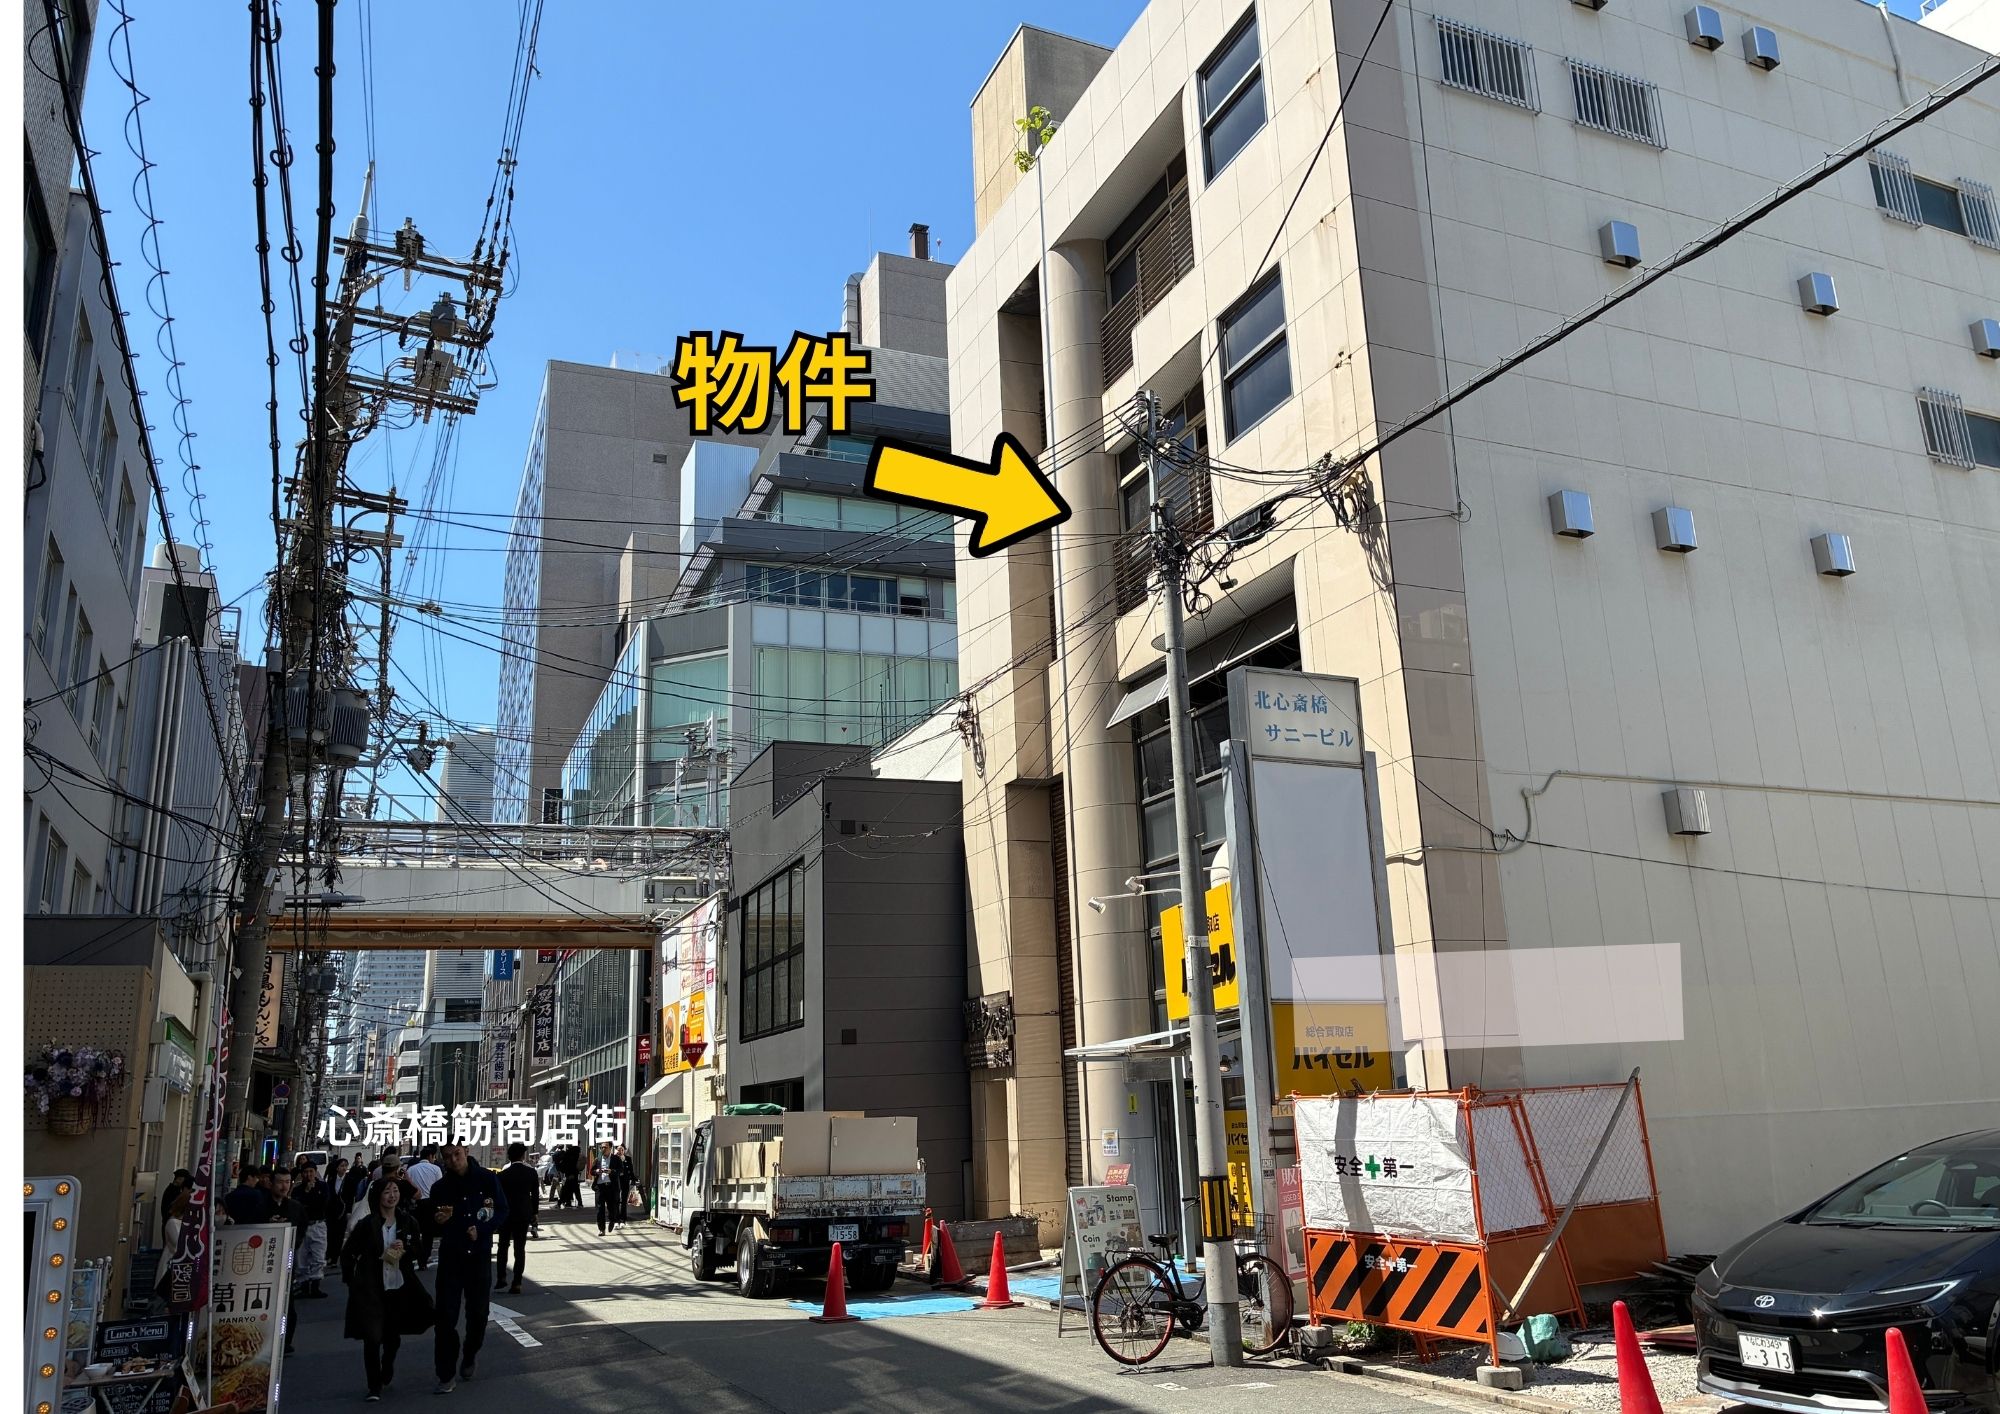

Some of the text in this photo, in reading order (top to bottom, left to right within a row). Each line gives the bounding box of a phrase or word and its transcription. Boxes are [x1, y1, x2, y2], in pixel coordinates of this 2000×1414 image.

[1254, 689, 1329, 715] 北心斎橋
[1264, 723, 1354, 747] サニービル
[1305, 1025, 1354, 1038] 総合買取店
[538, 1057, 548, 1065] 2F
[1292, 1046, 1375, 1070] バイセル
[1334, 1155, 1364, 1177] 安全
[1106, 1194, 1134, 1204] Stamp
[1082, 1234, 1101, 1243] Coin
[218, 1316, 256, 1325] MANRYO
[110, 1325, 163, 1340] Lunch Menu
